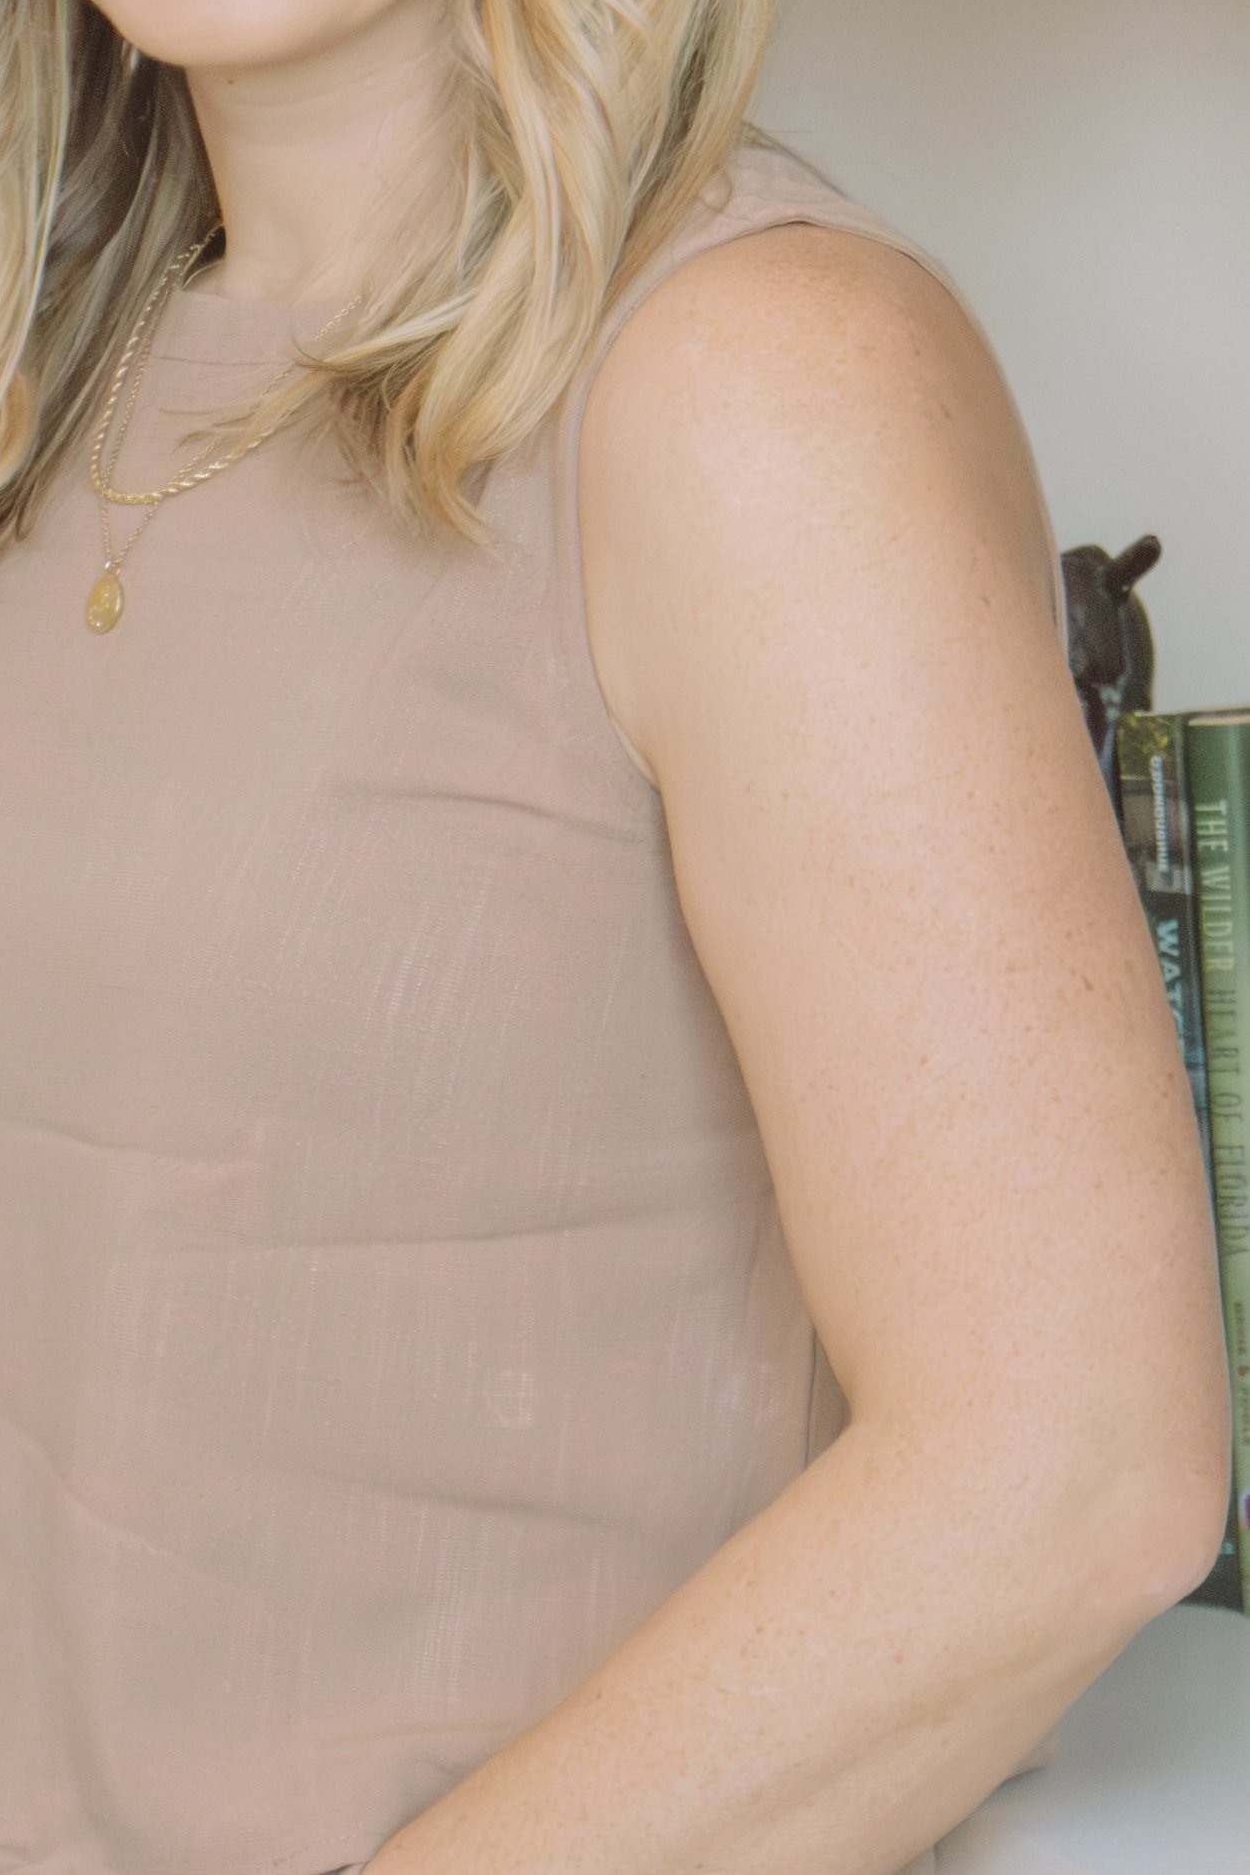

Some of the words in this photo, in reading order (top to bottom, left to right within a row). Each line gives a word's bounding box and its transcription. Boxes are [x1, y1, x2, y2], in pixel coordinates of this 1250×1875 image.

[1195, 800, 1229, 852] THE
[1201, 865, 1236, 971] WILDER
[1207, 987, 1240, 1077] HEART
